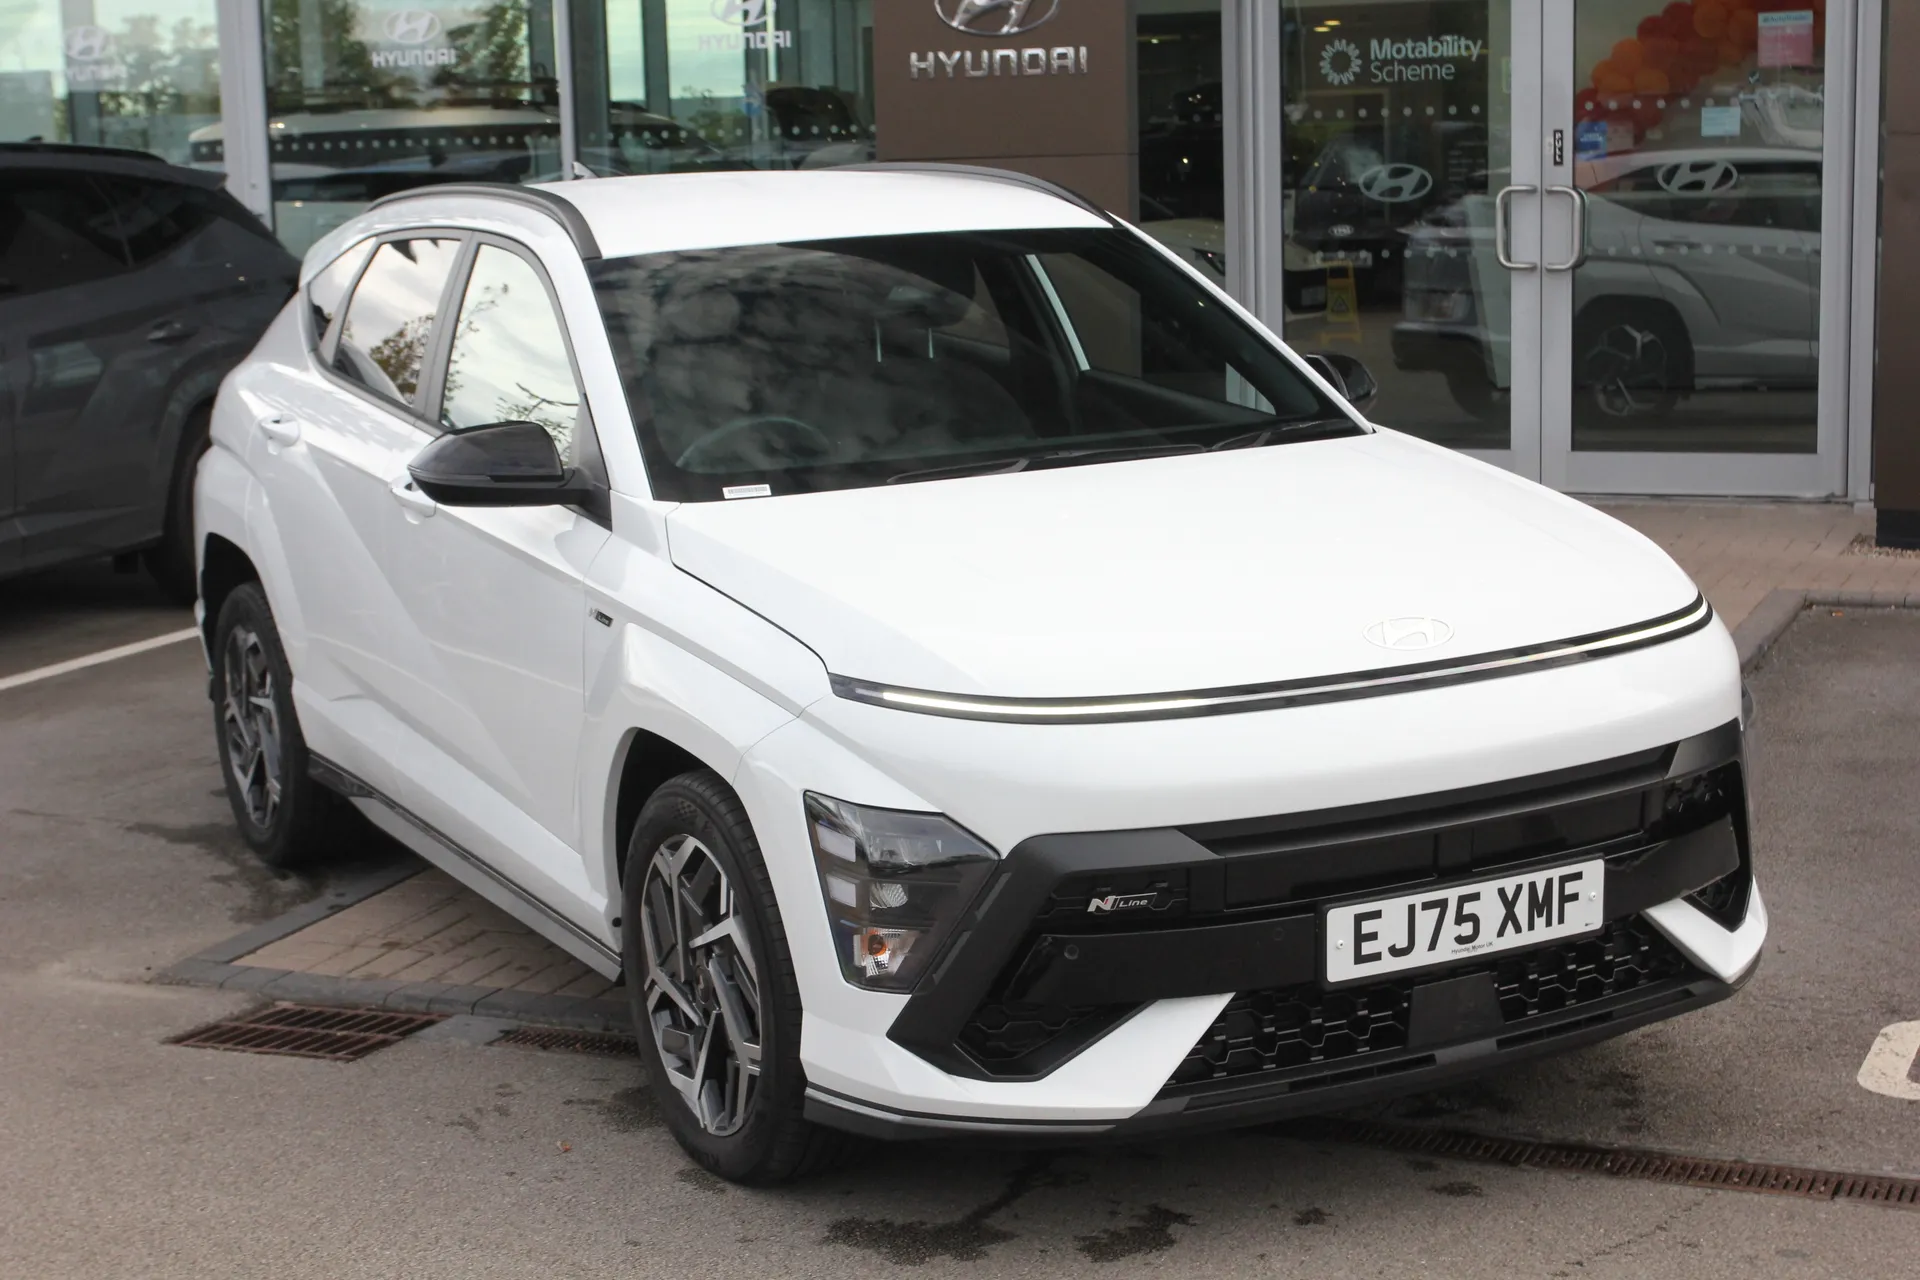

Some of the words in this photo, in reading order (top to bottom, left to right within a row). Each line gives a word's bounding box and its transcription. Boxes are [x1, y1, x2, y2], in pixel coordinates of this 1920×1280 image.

[699, 31, 791, 50] HYUNDAI
[1370, 34, 1482, 62] Motability
[372, 48, 456, 68] HYUNDAI
[909, 46, 1088, 80] HYUNDAI
[1370, 61, 1456, 83] Scheme
[1087, 895, 1116, 912] N
[1119, 899, 1148, 907] Line
[1353, 891, 1481, 966] EJ75
[1496, 870, 1583, 938] XMF
[1451, 945, 1471, 955] Hyundai
[1472, 942, 1486, 951] Motor
